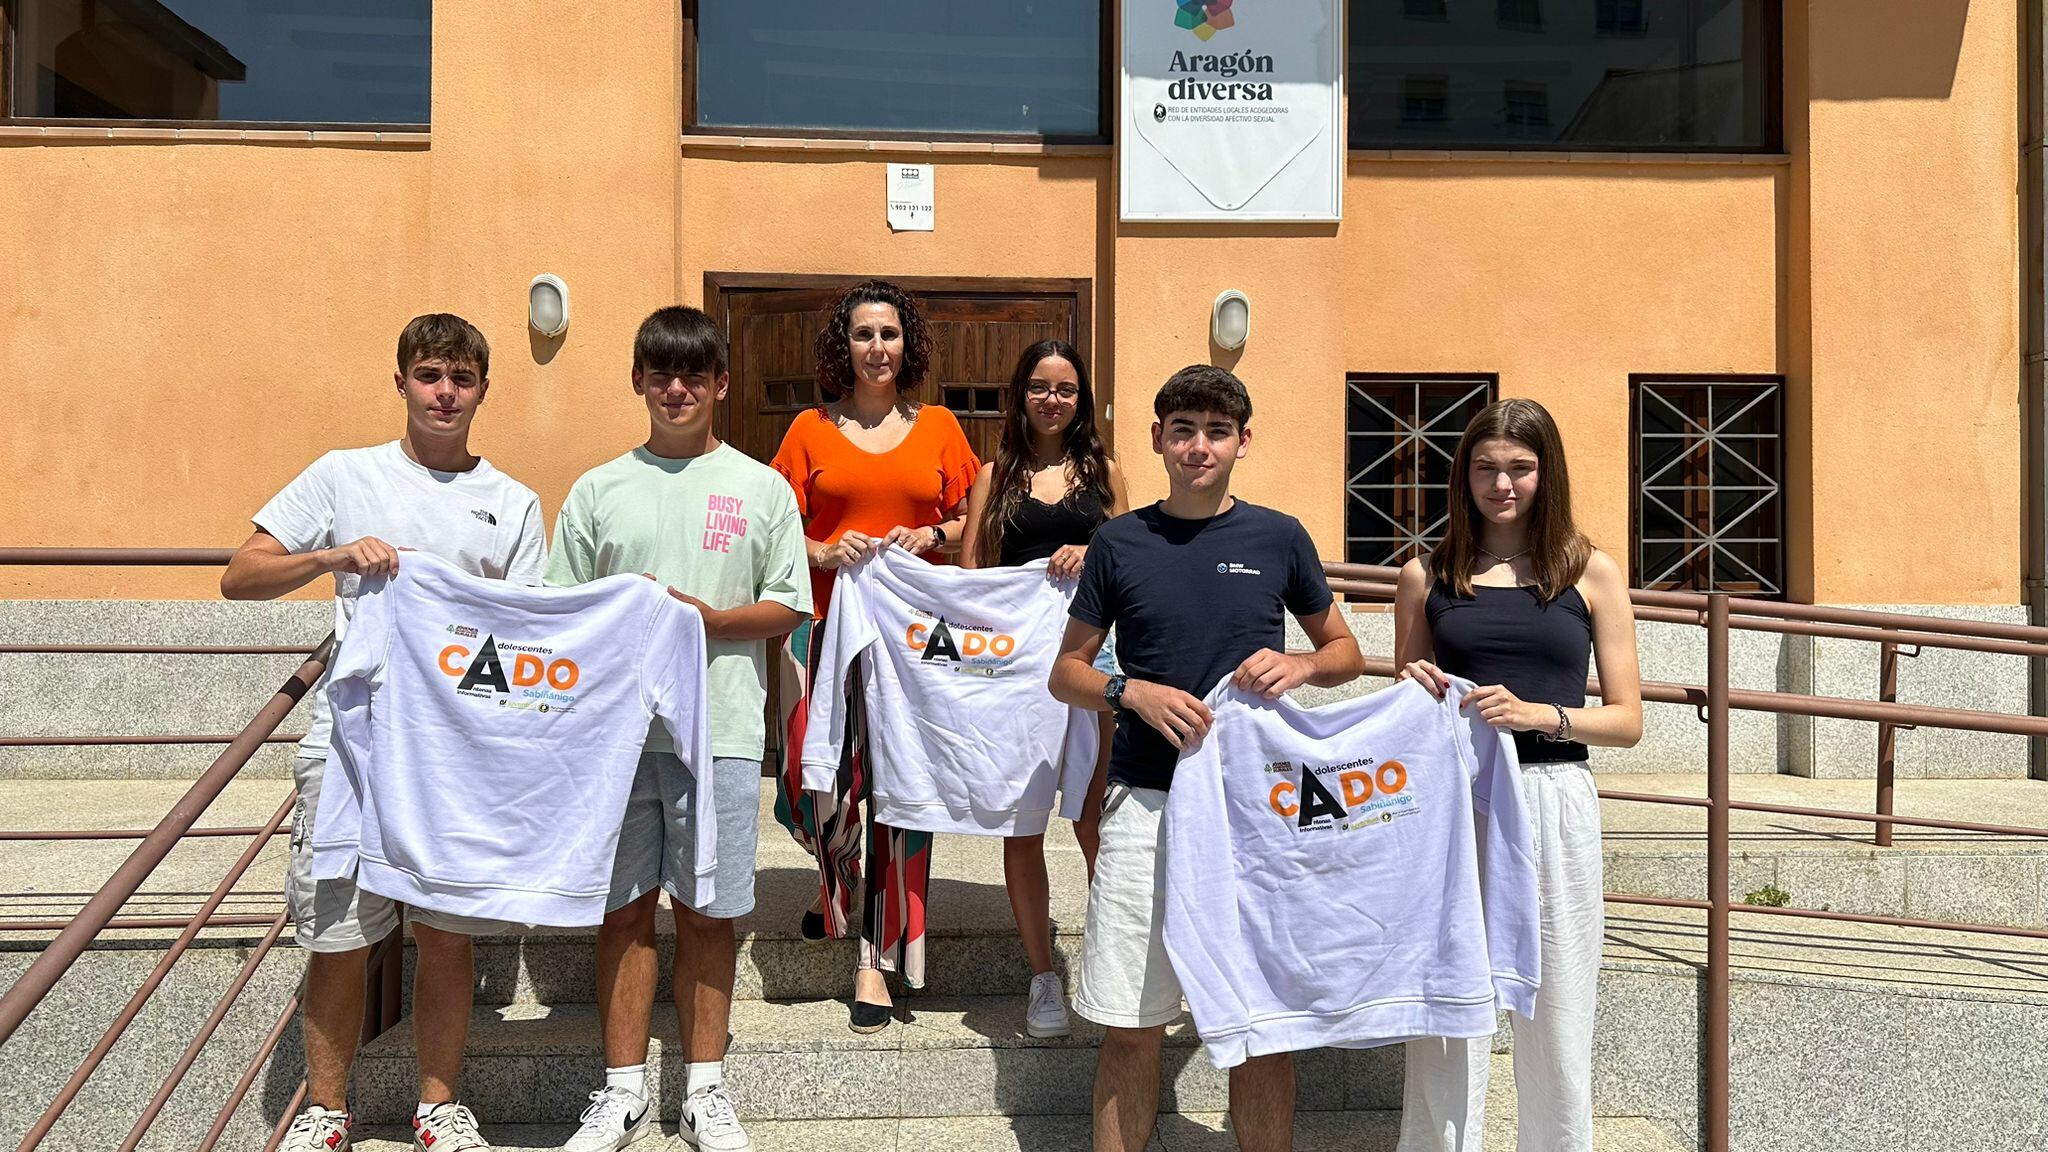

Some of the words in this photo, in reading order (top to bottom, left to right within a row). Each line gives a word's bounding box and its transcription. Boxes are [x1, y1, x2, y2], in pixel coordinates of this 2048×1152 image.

[1168, 49, 1274, 78] Aragón
[1168, 77, 1273, 101] diversa
[1167, 106, 1180, 114] RED
[1181, 106, 1189, 114] DE
[1190, 106, 1222, 114] ENTIDADES
[1223, 106, 1249, 114] LOCALES
[1250, 106, 1289, 114] ACOGEDORAS
[708, 494, 743, 516] BUSY
[705, 511, 748, 537] LIVING
[702, 530, 732, 554] LIFE
[523, 688, 576, 703] Sabiñánigo
[1360, 793, 1413, 814] Sabiñánigo
